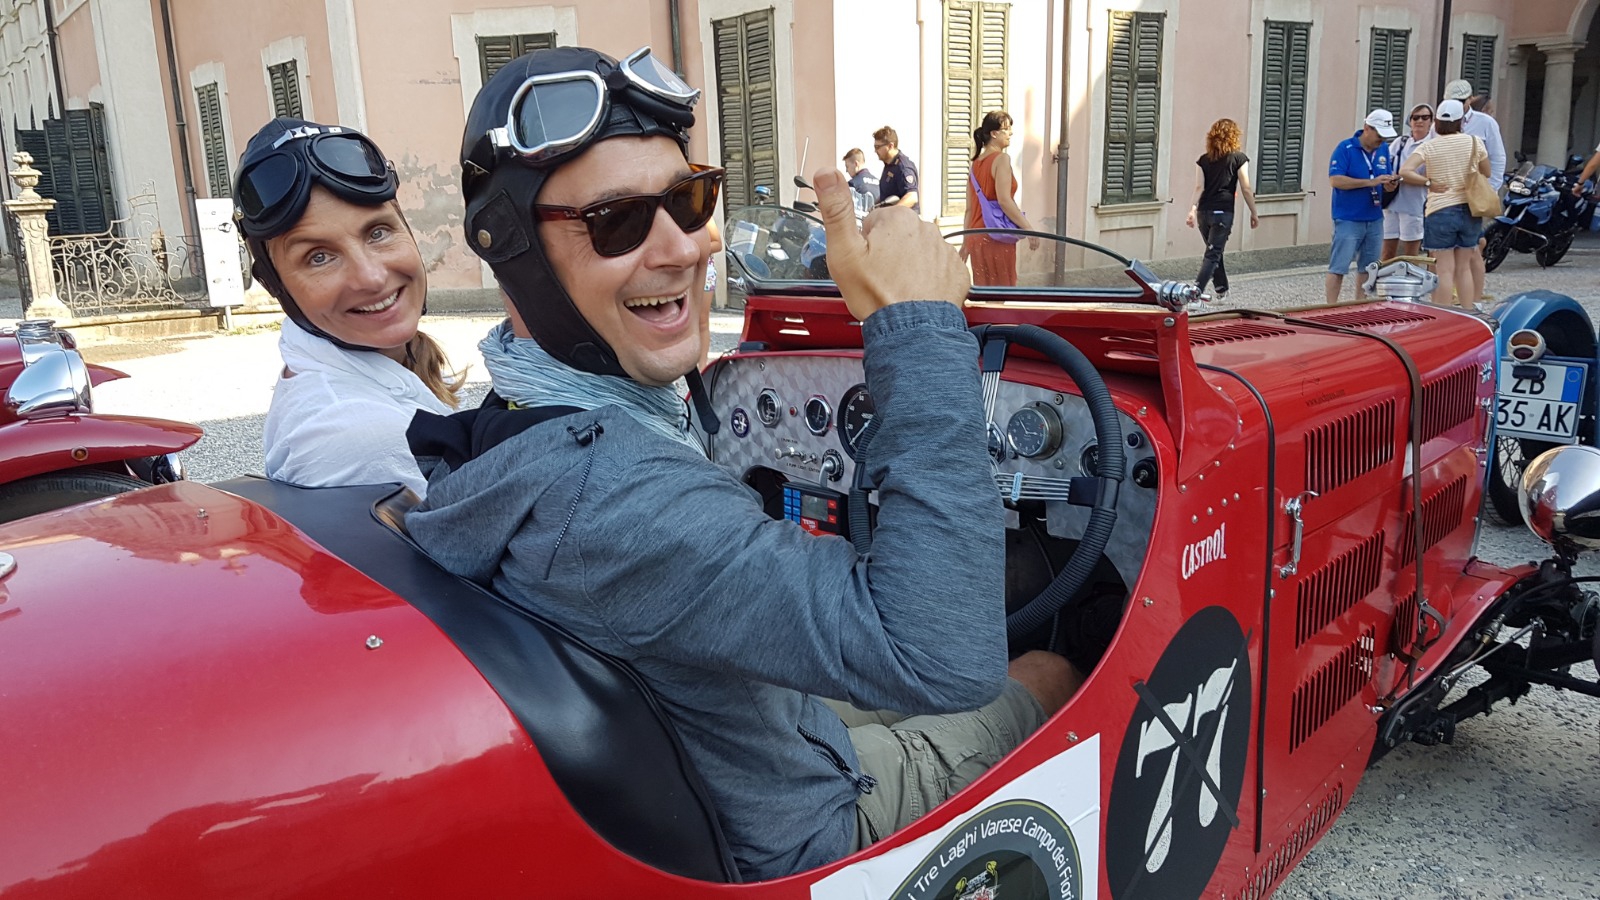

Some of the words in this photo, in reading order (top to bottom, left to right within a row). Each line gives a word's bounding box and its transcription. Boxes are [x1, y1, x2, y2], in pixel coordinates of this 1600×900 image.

[1536, 403, 1574, 433] AK
[1181, 521, 1227, 580] CASTROL
[980, 817, 1022, 839] Varese
[1022, 816, 1056, 855] Campo
[939, 826, 977, 868] Laghi
[1051, 846, 1069, 872] dei
[913, 866, 939, 893] Tre
[1058, 865, 1075, 900] Fiori
